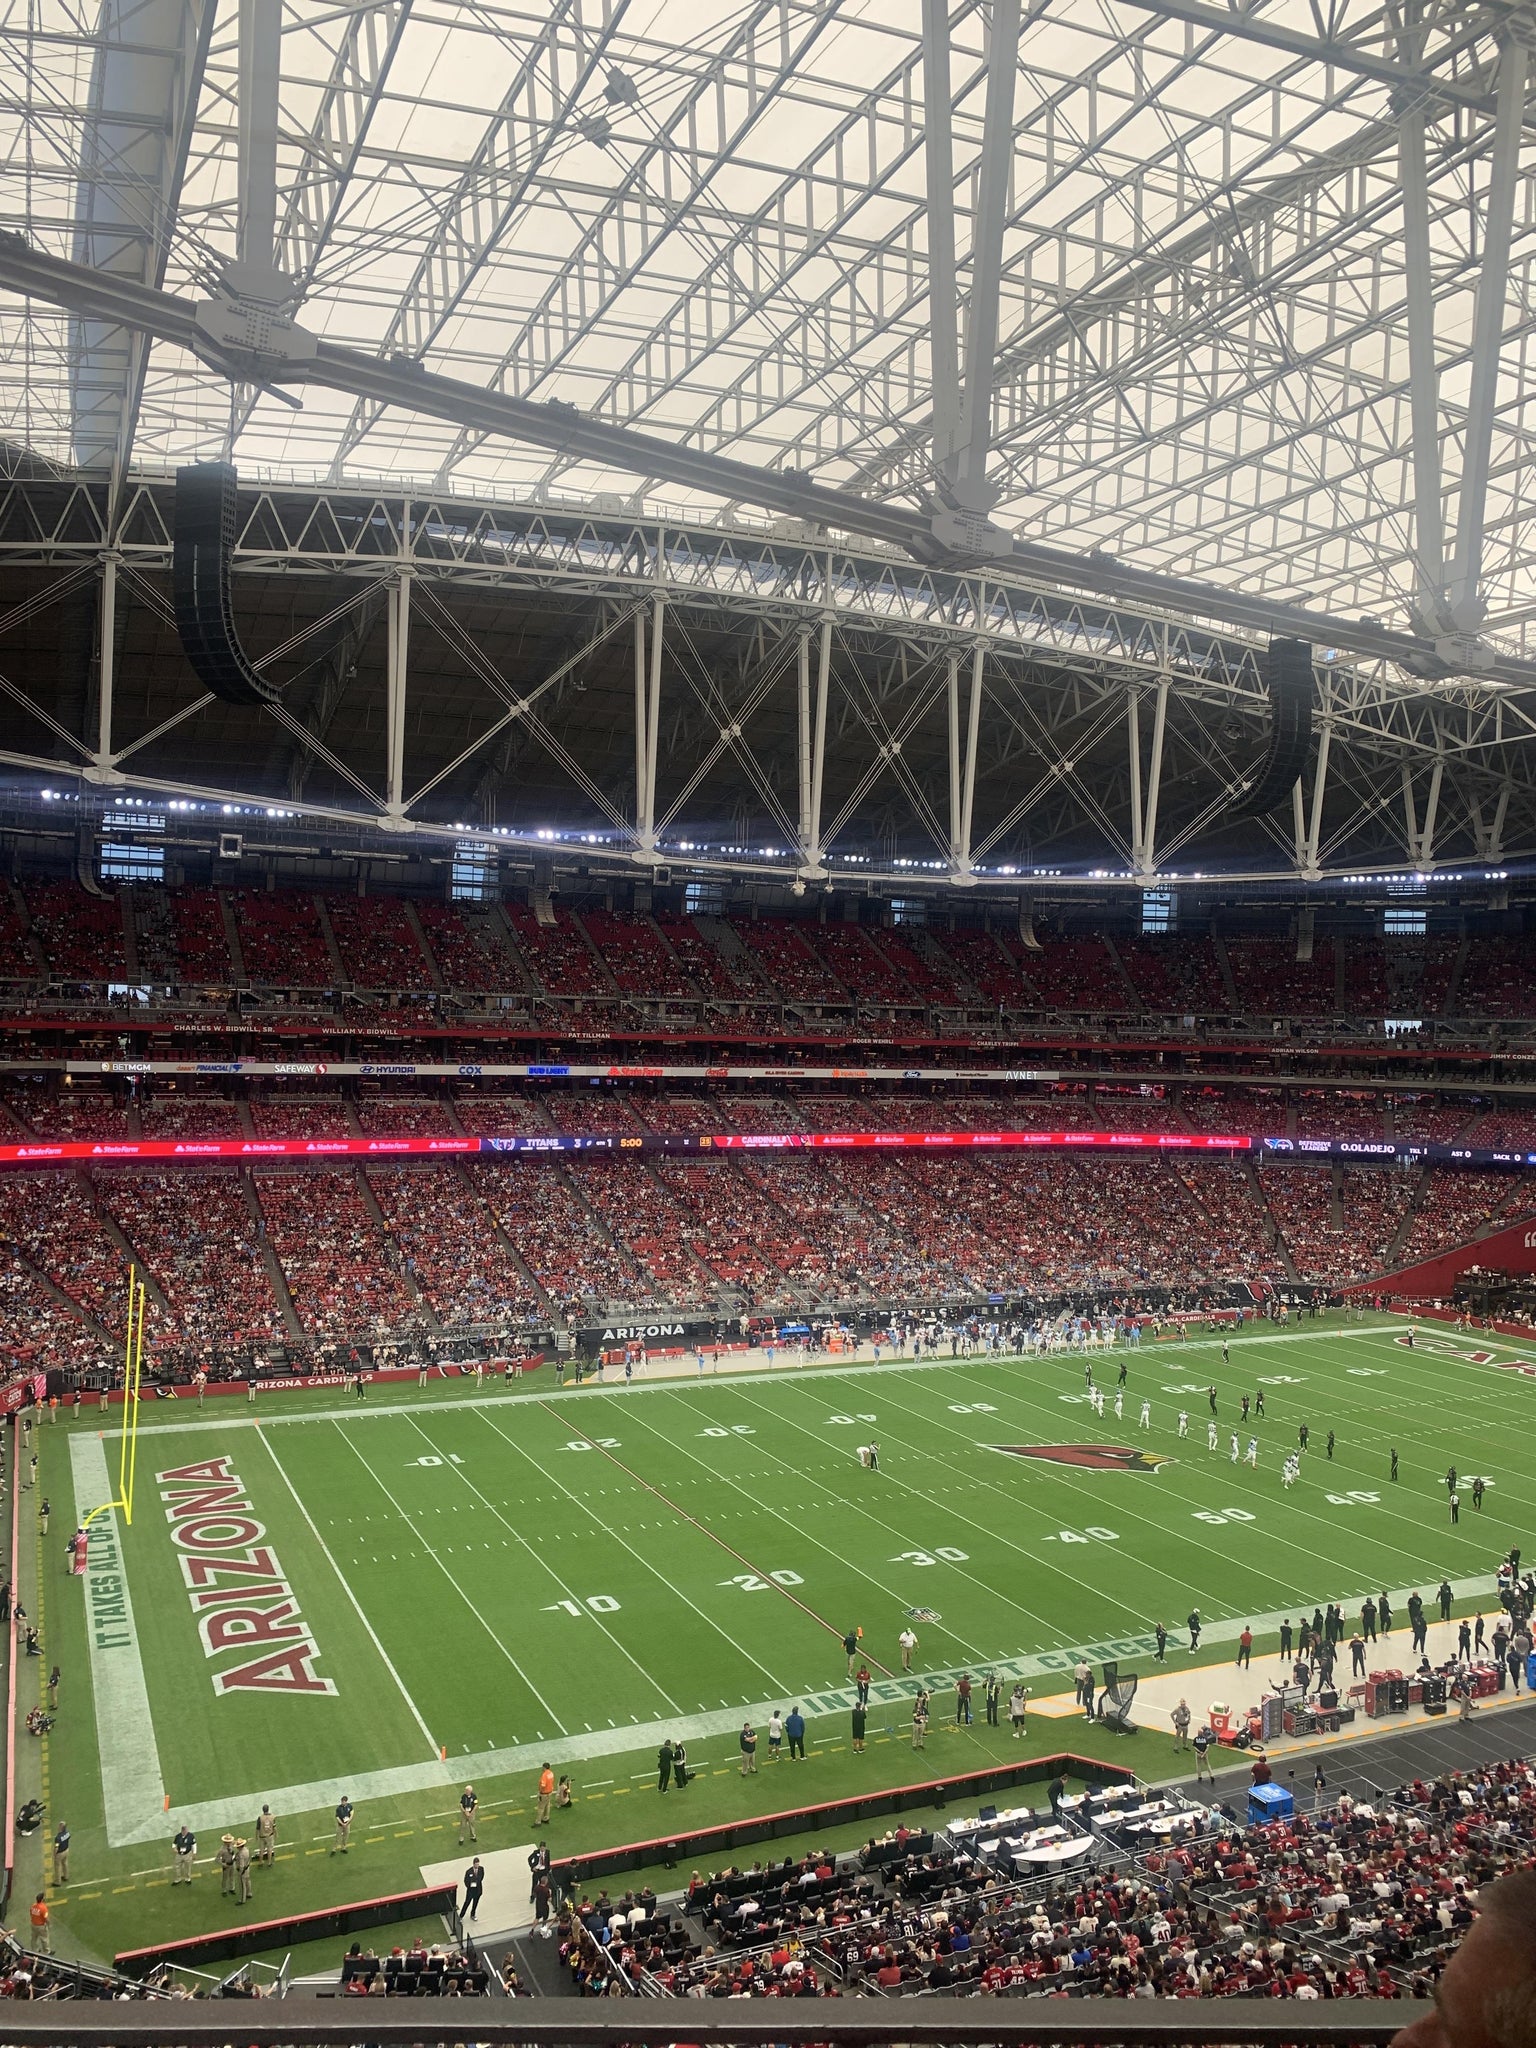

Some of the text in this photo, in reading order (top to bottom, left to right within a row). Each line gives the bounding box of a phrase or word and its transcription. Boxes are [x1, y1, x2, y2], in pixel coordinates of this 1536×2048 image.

[274, 1064, 314, 1073] SAFEWAY
[1006, 1071, 1038, 1080] AVNET
[574, 1139, 581, 1148] 3
[607, 1138, 612, 1147] 1
[620, 1138, 642, 1148] 5:00
[726, 1137, 733, 1145] 7
[742, 1136, 786, 1144] CARDINALS
[1341, 1143, 1395, 1153] O.OLADEJO
[602, 1324, 684, 1340] ARIZONA
[256, 1374, 374, 1390] RIZONA CARDIALS
[948, 1402, 999, 1414] 50
[832, 1412, 878, 1425] 40
[705, 1424, 756, 1438] 30
[567, 1438, 622, 1452] 20
[416, 1454, 466, 1468] 10
[1325, 1490, 1380, 1506] 40
[1190, 1507, 1257, 1526] 50
[1058, 1526, 1120, 1546] 40
[88, 1544, 119, 1572] ALL
[900, 1546, 970, 1567] 30
[155, 1455, 340, 1697] ARIZONA
[731, 1568, 806, 1593] 20
[90, 1574, 128, 1629] TAKES
[555, 1594, 622, 1618] 10
[96, 1632, 132, 1650] IT
[904, 1925, 914, 1936] 81
[1158, 1930, 1171, 1942] 40
[847, 1951, 859, 1963] 69
[992, 1978, 1002, 1989] 31
